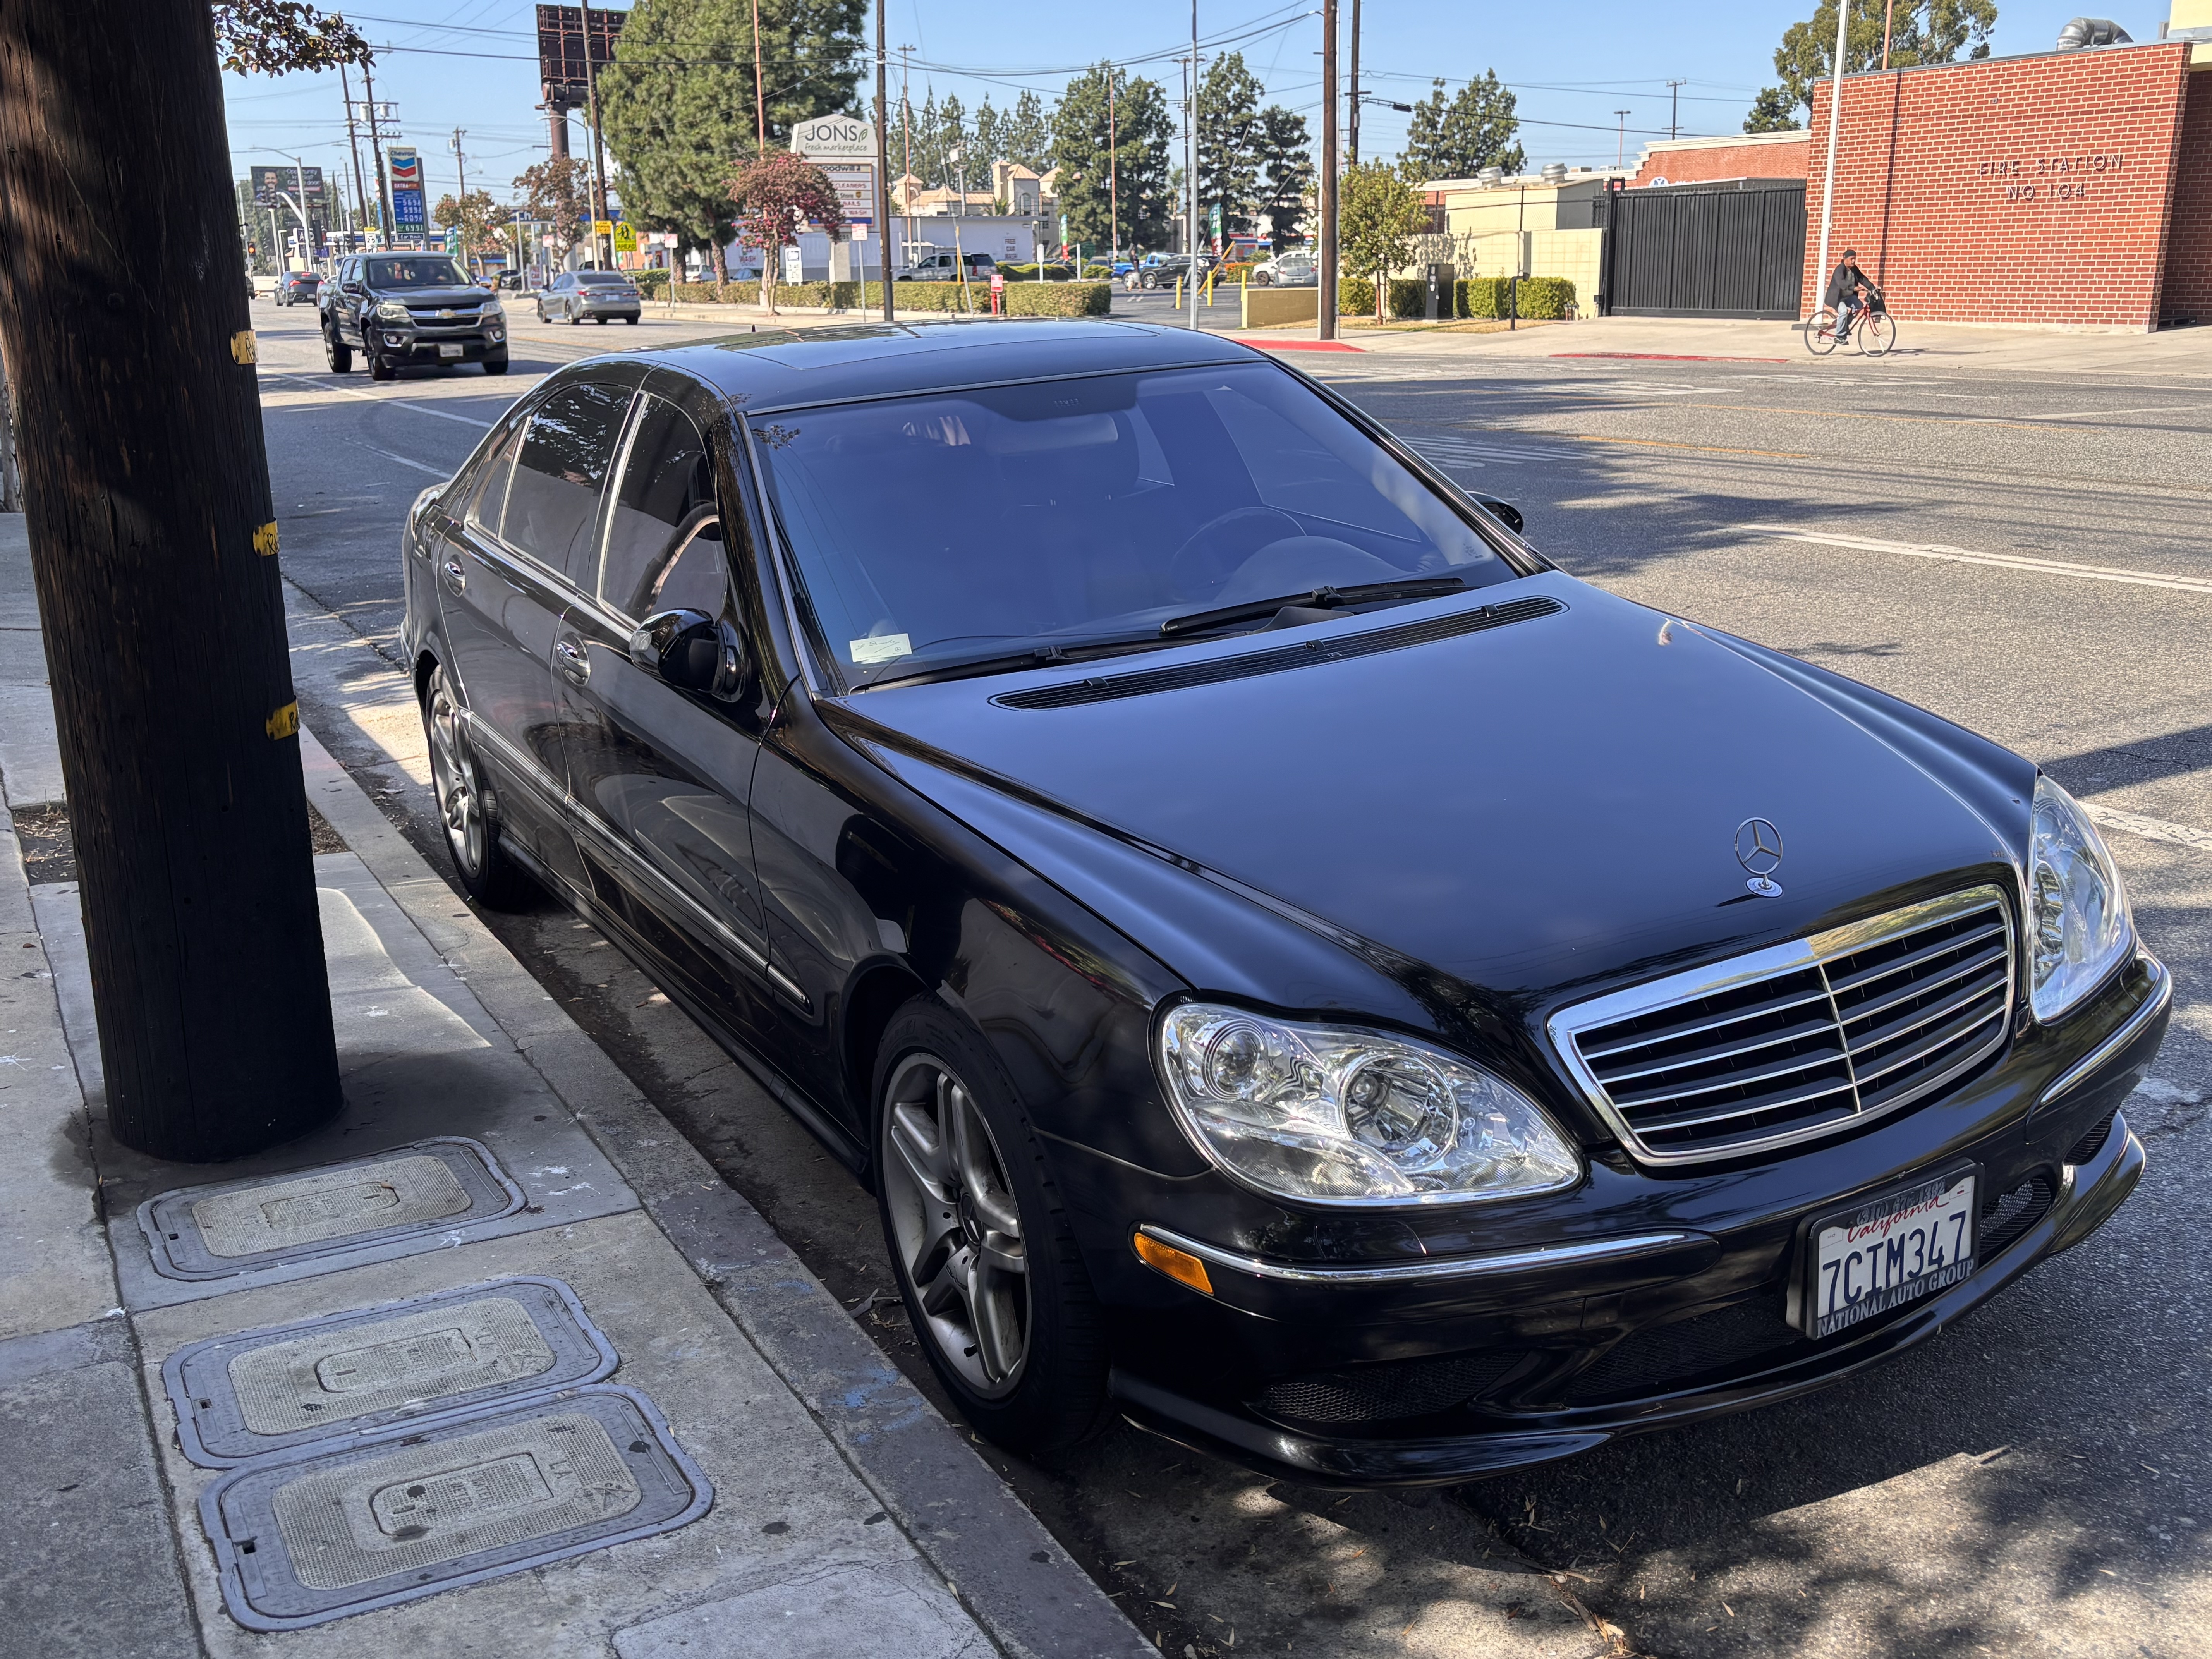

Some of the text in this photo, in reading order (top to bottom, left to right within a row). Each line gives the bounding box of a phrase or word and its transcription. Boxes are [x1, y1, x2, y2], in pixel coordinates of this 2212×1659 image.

[805, 125, 857, 141] JONS
[805, 143, 868, 153] fresh marketplace
[1980, 155, 2123, 177] FIRE STATION
[2007, 182, 2085, 201] NO 104
[1847, 1196, 1949, 1243] California
[1822, 1210, 1966, 1314] 7CIM347
[1817, 1259, 1974, 1339] NATIONAL AUTO GROUP
